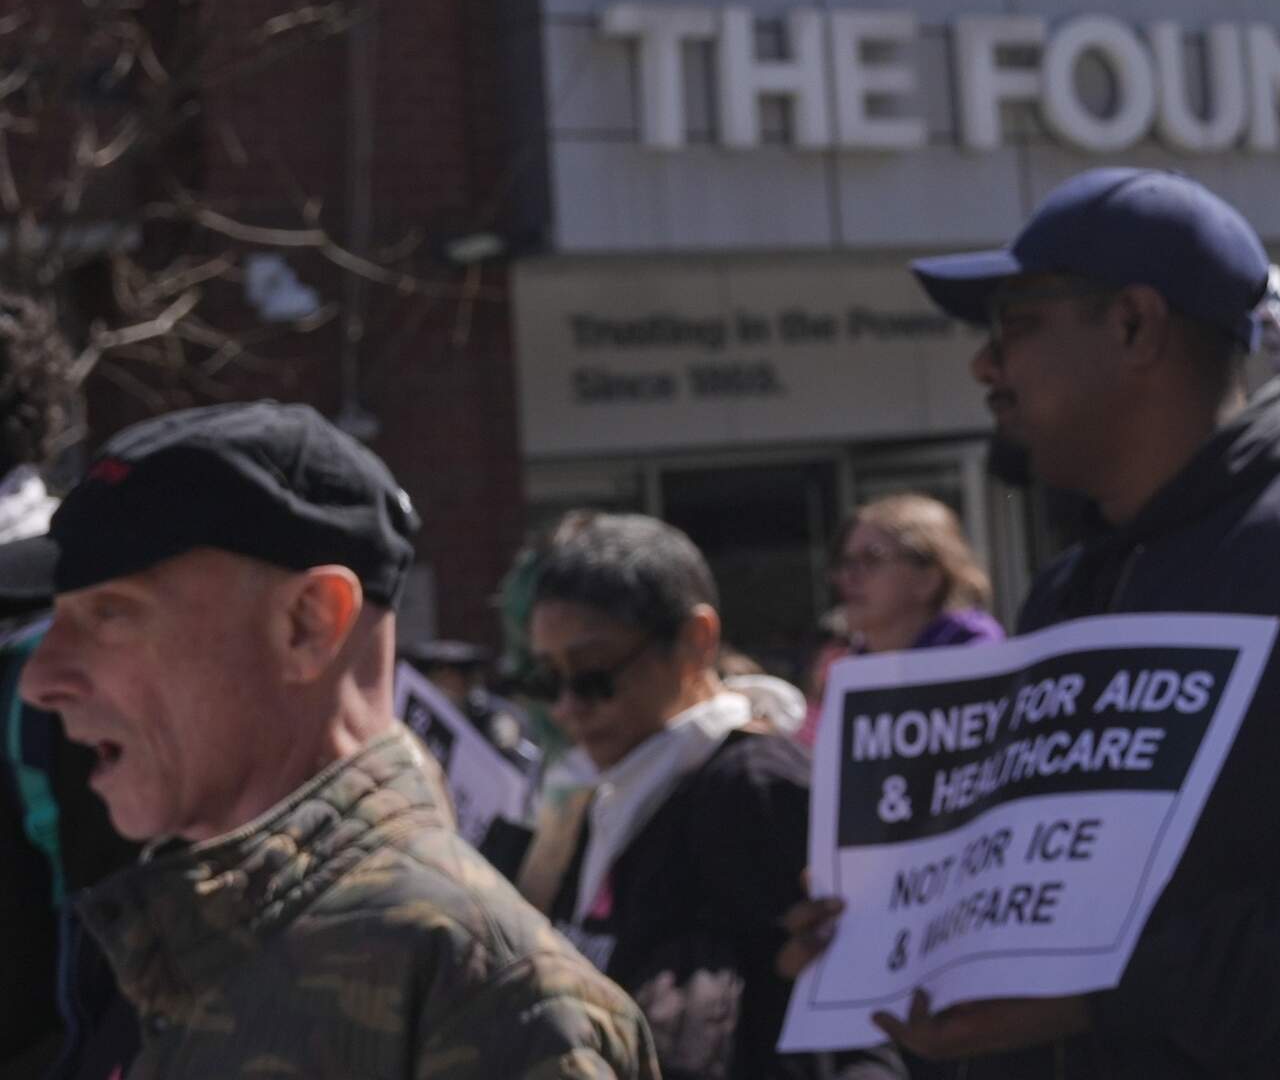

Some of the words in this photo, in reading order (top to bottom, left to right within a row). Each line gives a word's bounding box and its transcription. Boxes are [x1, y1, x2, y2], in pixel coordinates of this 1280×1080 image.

[601, 3, 927, 152] THE
[851, 698, 1010, 762] MONEY
[1008, 671, 1085, 731] FOR
[1095, 669, 1215, 714] AIDS
[877, 774, 913, 822] &
[930, 726, 1167, 816] HEALTHCARE
[888, 853, 956, 913] NOT
[1026, 818, 1103, 865] ICE
[887, 928, 911, 974] &
[919, 881, 1064, 960] WARFARE
